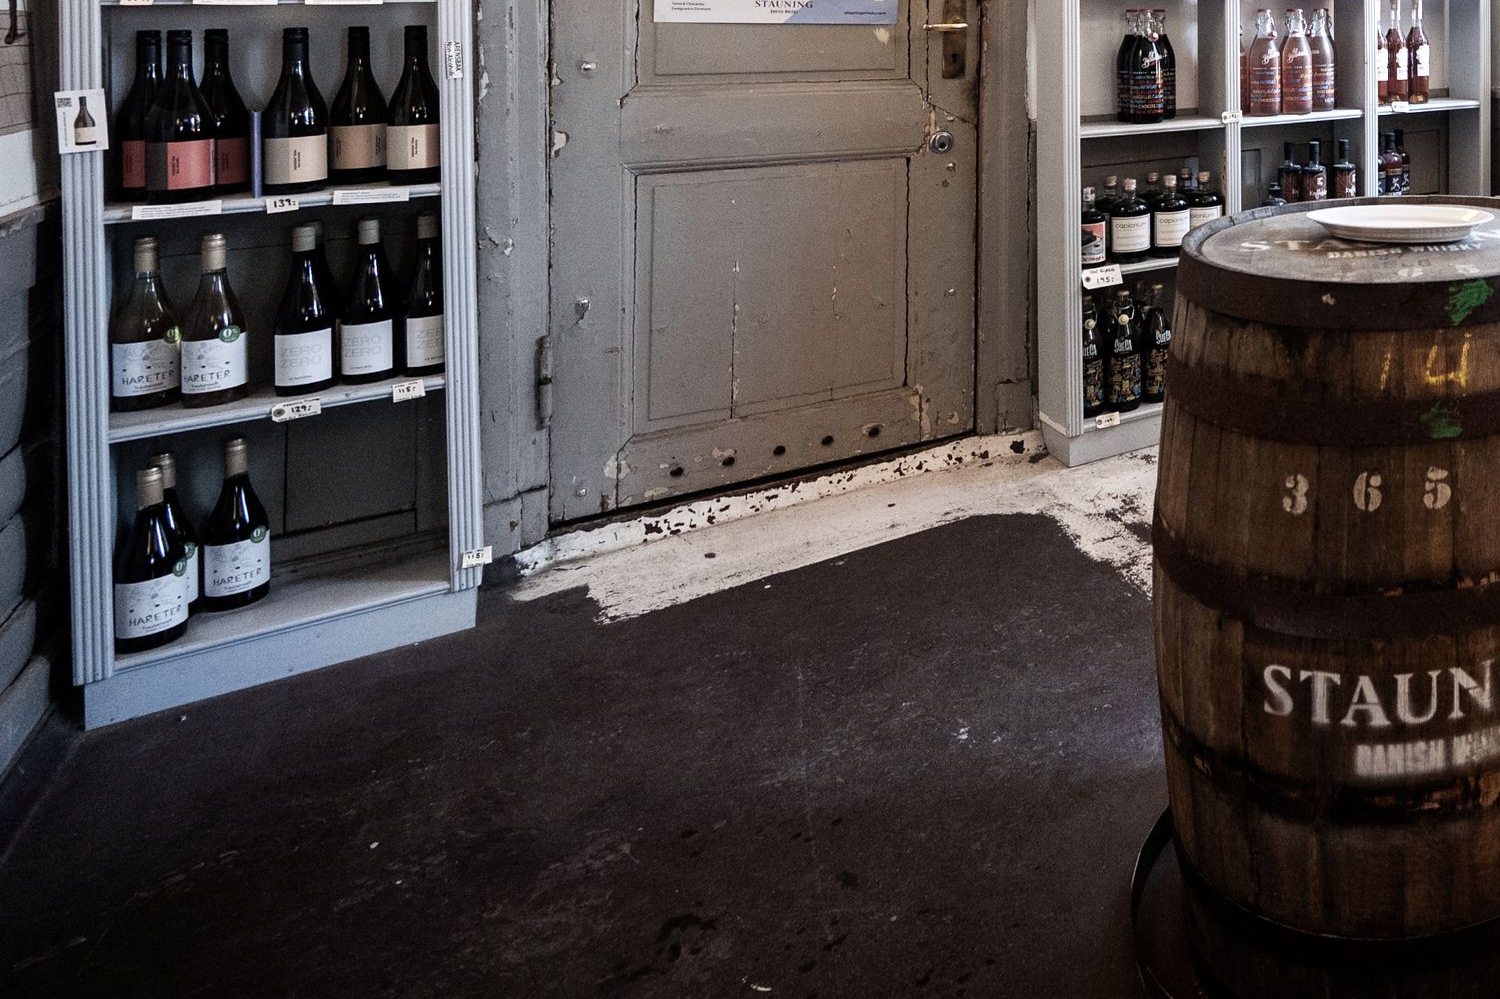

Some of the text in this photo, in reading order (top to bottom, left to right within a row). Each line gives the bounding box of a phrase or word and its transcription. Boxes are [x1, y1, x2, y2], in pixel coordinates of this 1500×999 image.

[754, 0, 814, 9] STAUNING
[1282, 473, 1309, 514] 3
[1353, 470, 1382, 512] 6
[1423, 465, 1452, 510] 5
